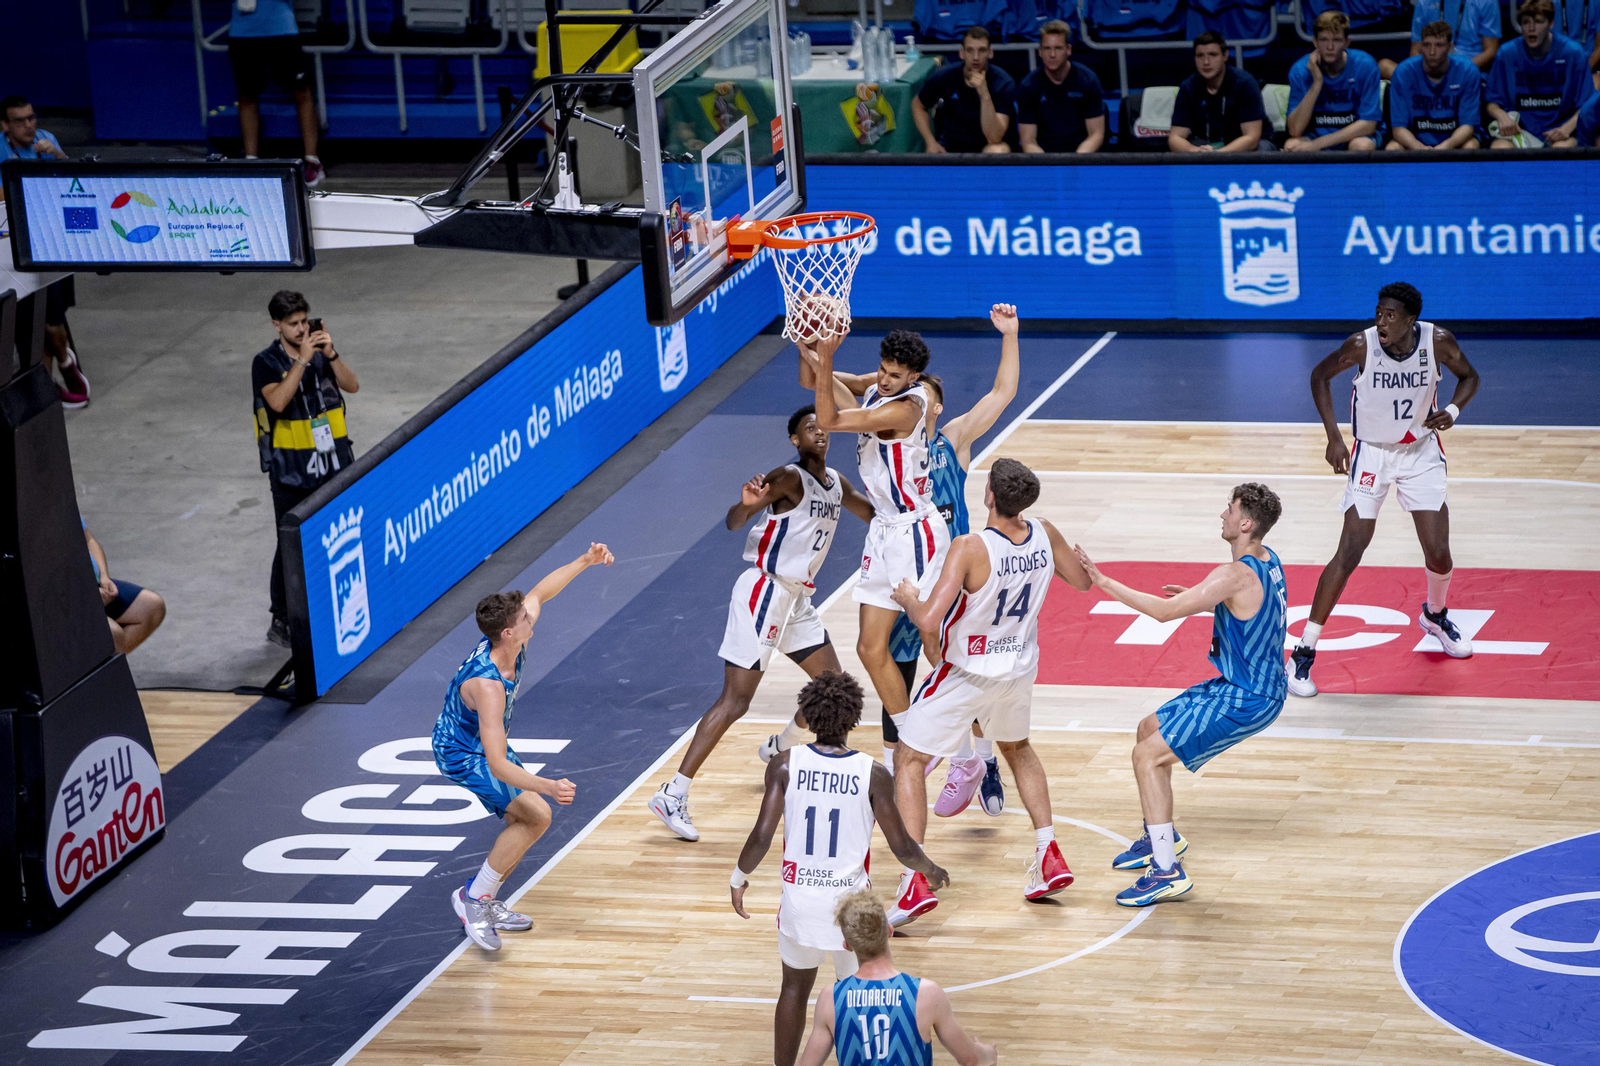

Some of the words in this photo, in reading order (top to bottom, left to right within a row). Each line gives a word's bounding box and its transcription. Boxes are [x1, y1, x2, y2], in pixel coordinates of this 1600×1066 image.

[166, 197, 250, 217] Andalucía
[168, 222, 205, 232] European
[206, 223, 233, 231] Region
[236, 222, 244, 231] of
[896, 219, 952, 256] de
[968, 215, 1142, 266] Málaga
[1373, 370, 1429, 389] FRANCE
[1393, 399, 1414, 421] 12
[306, 451, 341, 479] 401
[384, 430, 522, 567] Ayuntamiento
[526, 402, 552, 446] de
[554, 348, 625, 429] Málaga
[996, 549, 1047, 578] JACQUES
[991, 583, 1031, 627] 14
[987, 635, 1018, 648] CAISSE
[61, 744, 134, 829] 百岁山
[797, 769, 860, 796] PIETRUS
[55, 781, 165, 895] Ganten
[804, 806, 840, 858] 11
[797, 877, 854, 888] D'EPARGNE
[798, 867, 834, 879] CAISSE
[846, 988, 903, 1008] DIZDAREVIC
[858, 1013, 890, 1060] 10
